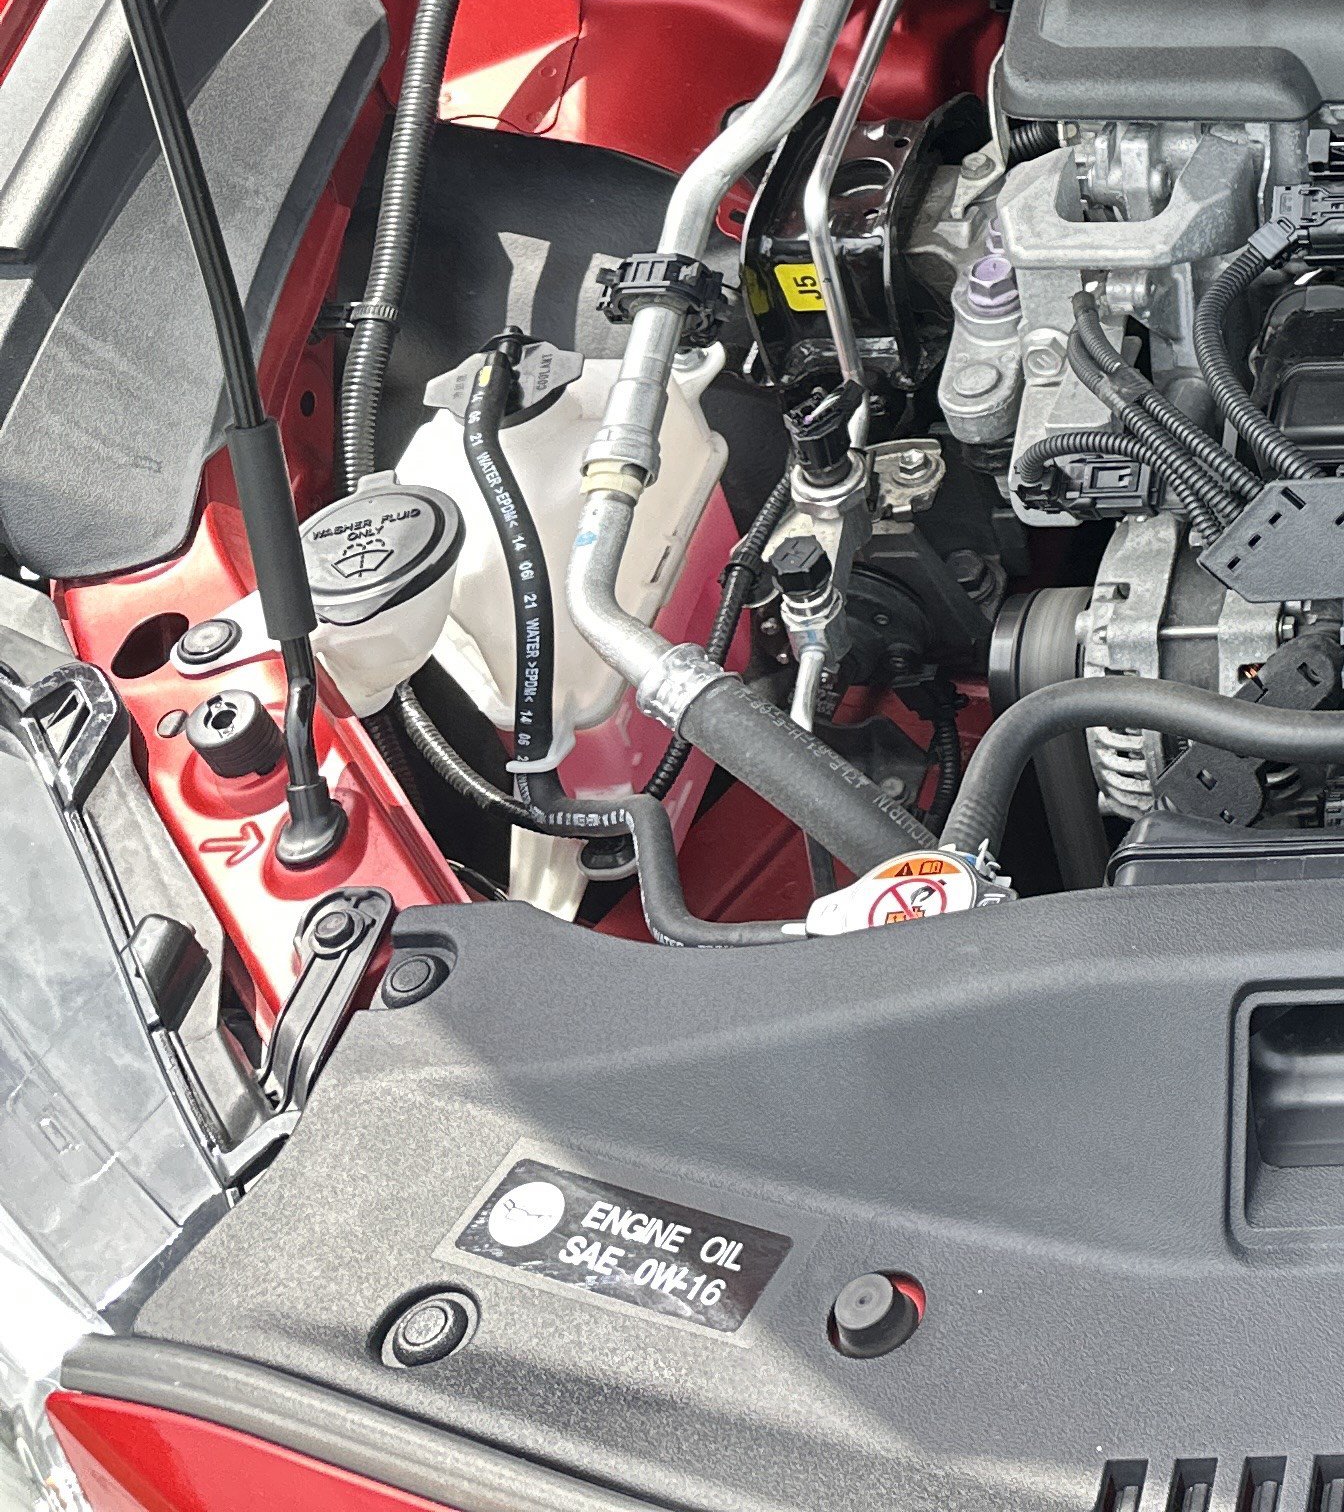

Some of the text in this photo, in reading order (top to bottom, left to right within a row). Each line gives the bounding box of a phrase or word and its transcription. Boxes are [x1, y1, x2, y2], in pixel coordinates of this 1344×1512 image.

[792, 275, 823, 300] J5
[536, 353, 553, 391] COOLANT
[469, 432, 484, 447] 21
[476, 450, 502, 488] WATER
[312, 507, 422, 541] WASHER FLUID
[346, 525, 385, 541] ONLY
[511, 533, 527, 552] 14
[518, 560, 535, 581] 06
[523, 593, 538, 609] 21
[524, 617, 540, 659] WATER
[518, 709, 534, 725] 14
[580, 1200, 746, 1272] ENGINE OIL
[558, 1235, 727, 1307] SAE 0W-16
